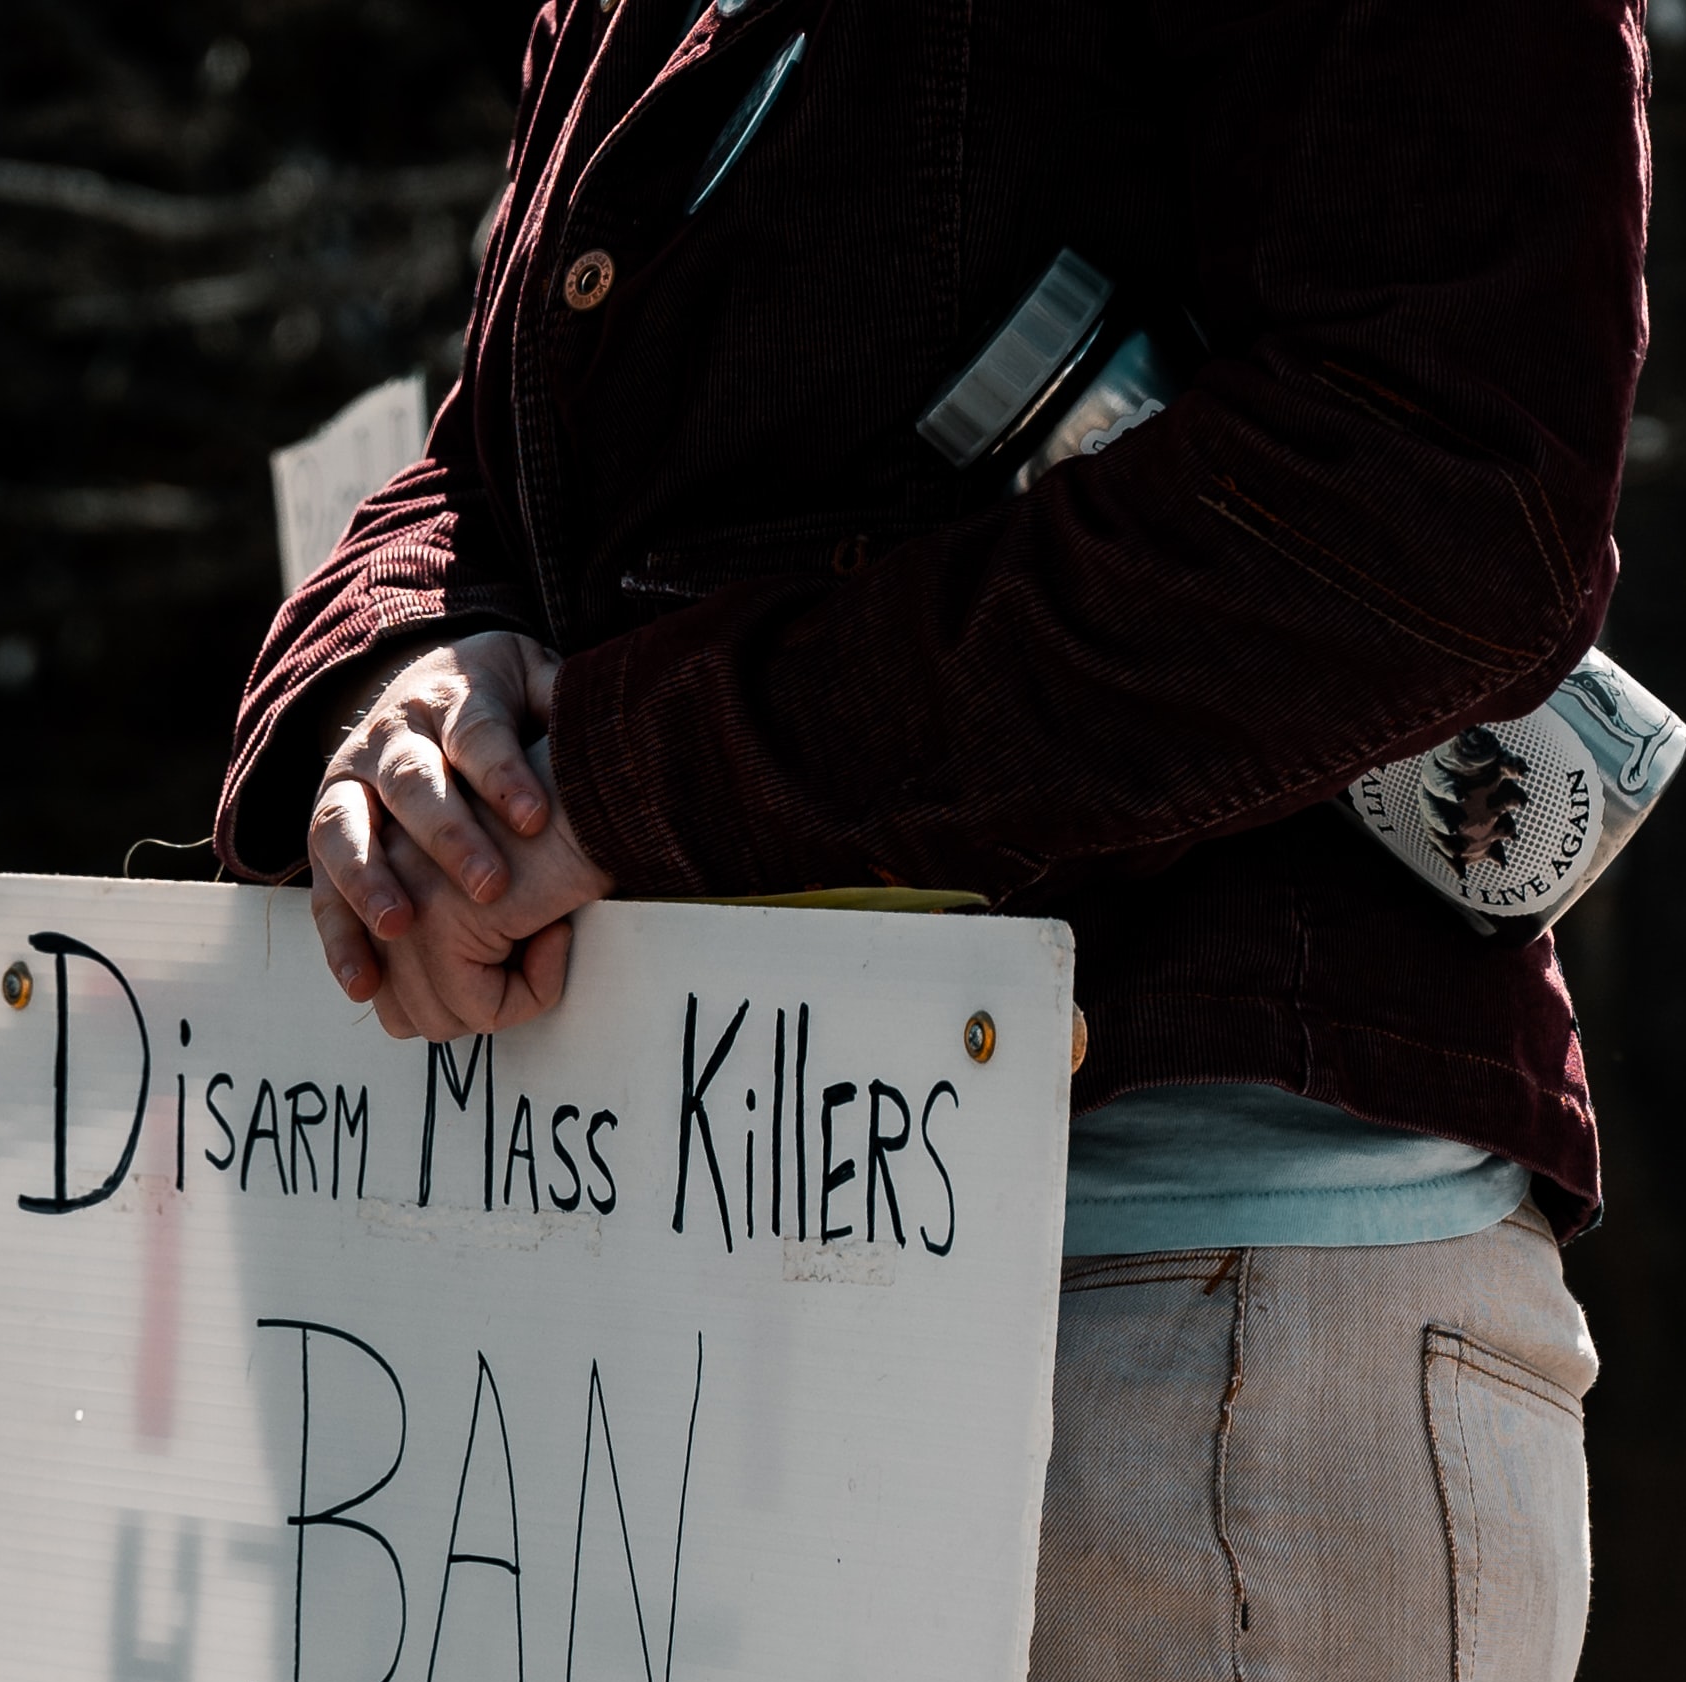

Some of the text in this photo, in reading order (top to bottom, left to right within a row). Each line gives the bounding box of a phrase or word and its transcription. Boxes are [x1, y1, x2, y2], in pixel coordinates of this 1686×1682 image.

[1361, 765, 1386, 817] LIV
[1480, 874, 1552, 905] LIVE
[1551, 768, 1590, 880] AGAIN
